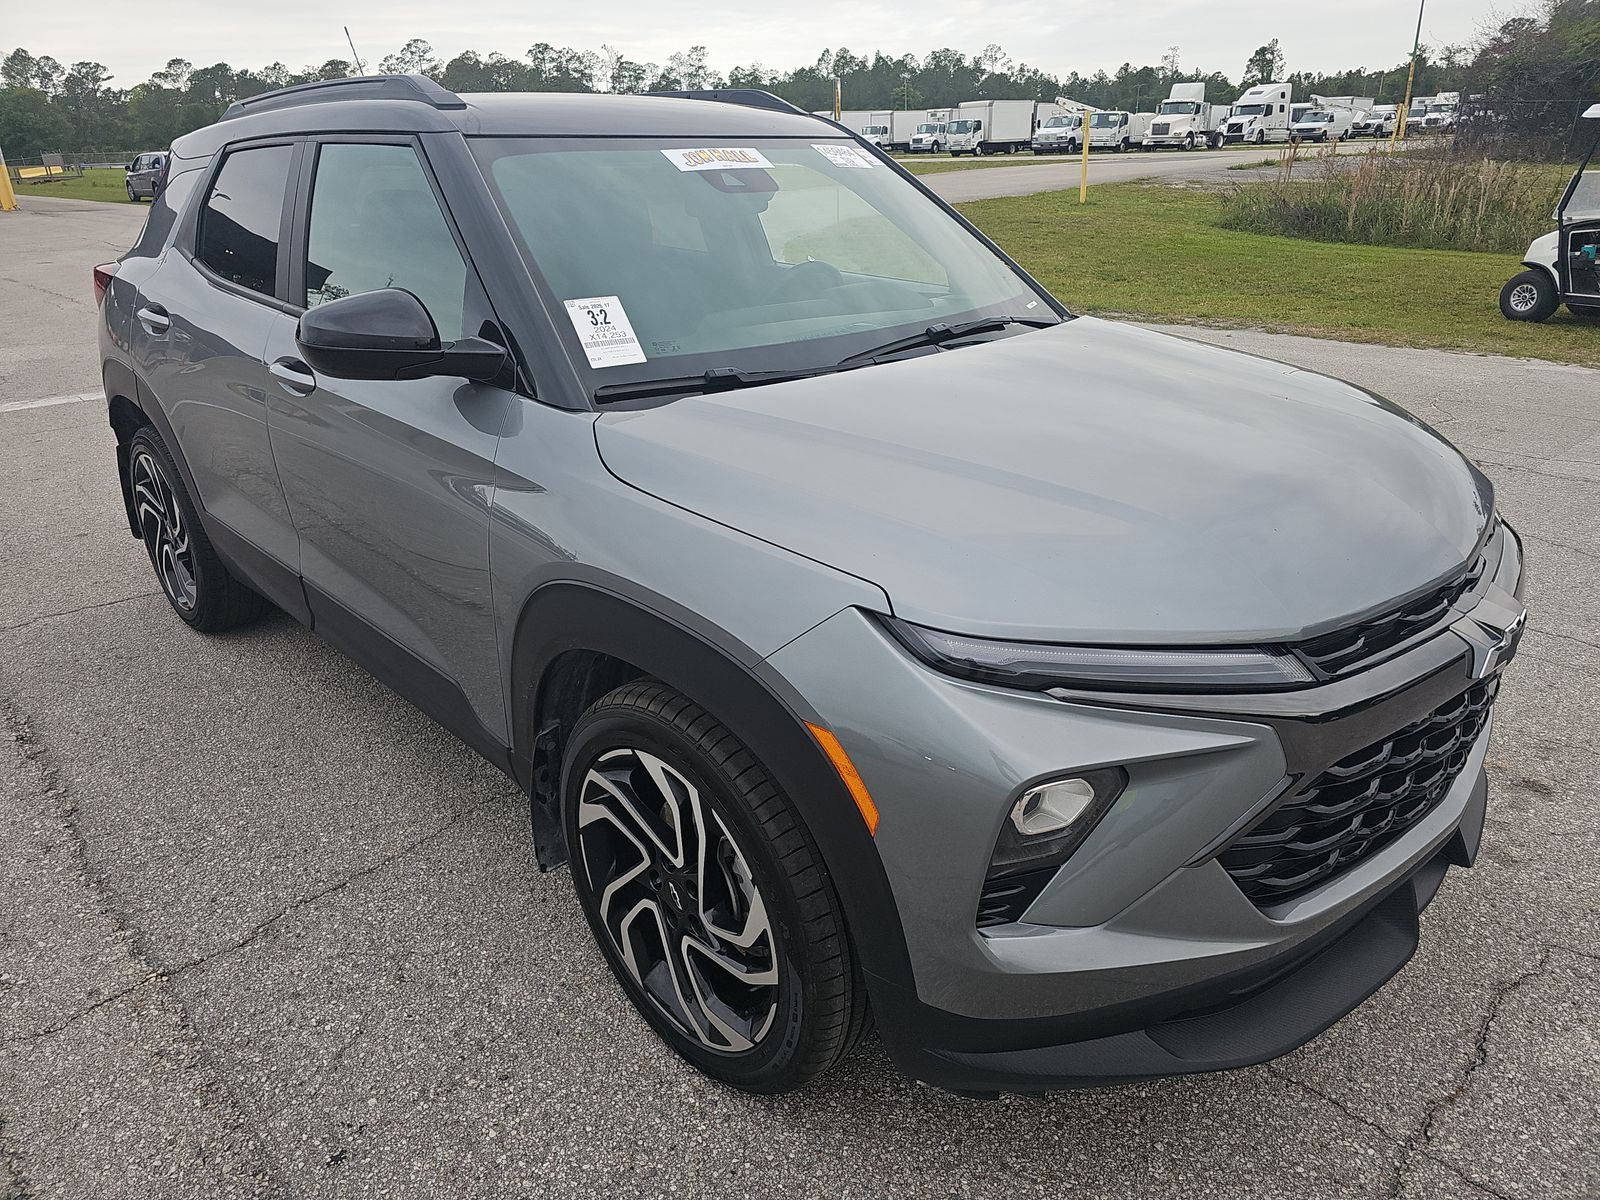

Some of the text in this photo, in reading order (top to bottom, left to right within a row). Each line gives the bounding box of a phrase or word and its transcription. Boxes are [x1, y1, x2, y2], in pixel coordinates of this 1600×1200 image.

[708, 149, 759, 163] HALL
[587, 309, 611, 326] 3:2
[593, 325, 617, 333] 2024
[589, 331, 627, 341] X14,253
